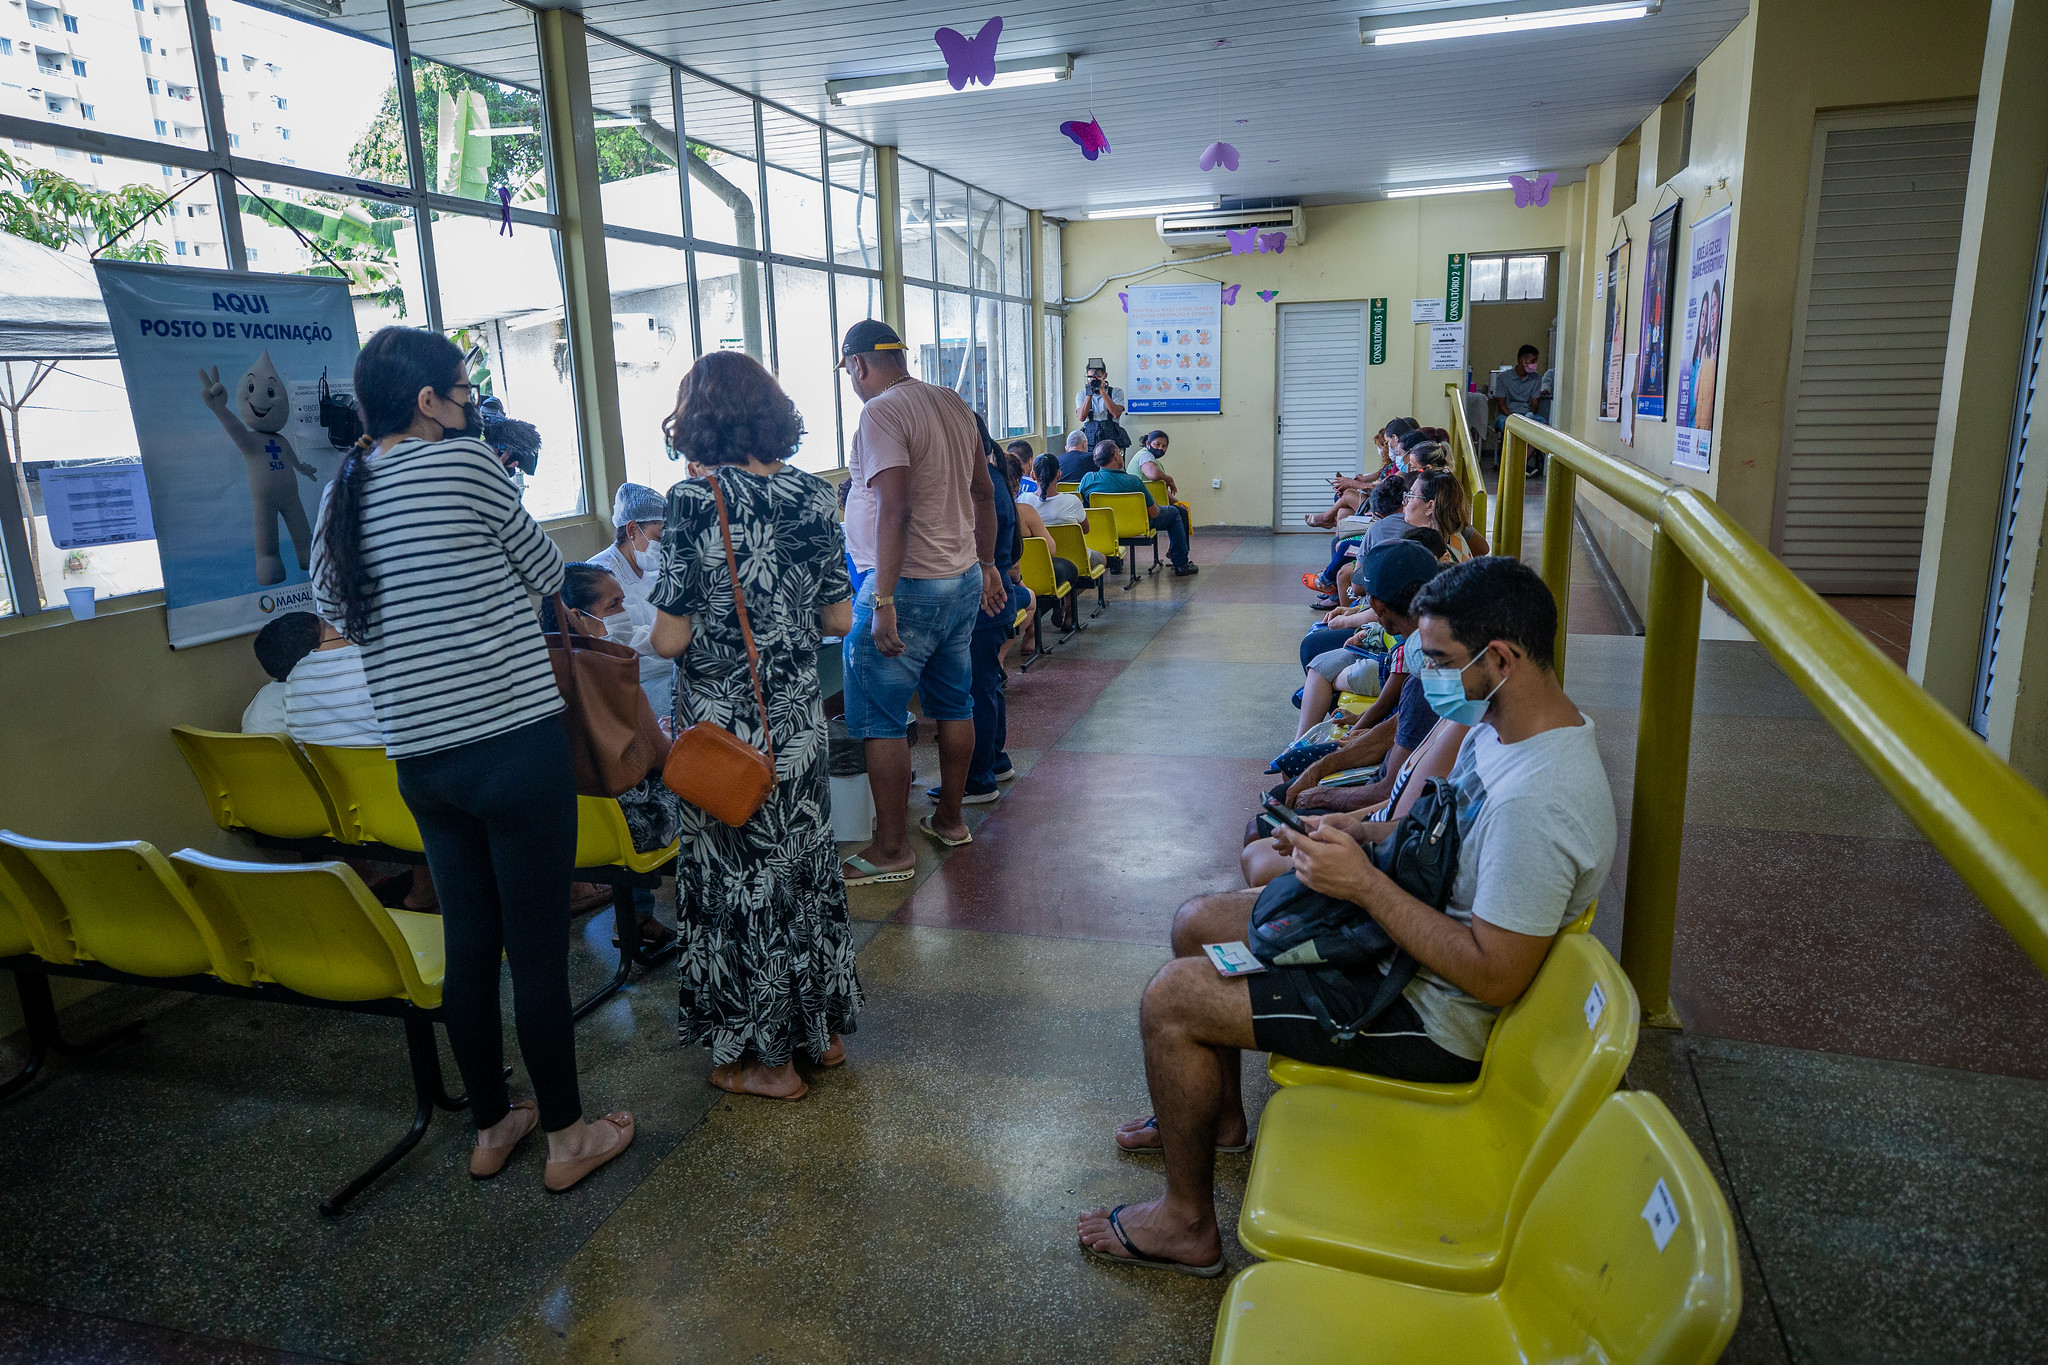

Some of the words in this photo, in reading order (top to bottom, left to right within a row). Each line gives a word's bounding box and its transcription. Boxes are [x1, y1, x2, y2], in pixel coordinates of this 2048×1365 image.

[212, 292, 270, 314] AQUI
[1449, 277, 1460, 321] CONSULTÓRIO
[140, 319, 207, 338] POSTO
[212, 321, 236, 338] DE
[239, 321, 333, 345] VACINAÇÃO
[1372, 321, 1383, 364] CONSULTÓRIO
[303, 404, 319, 412] 0800
[270, 461, 285, 471] SUS
